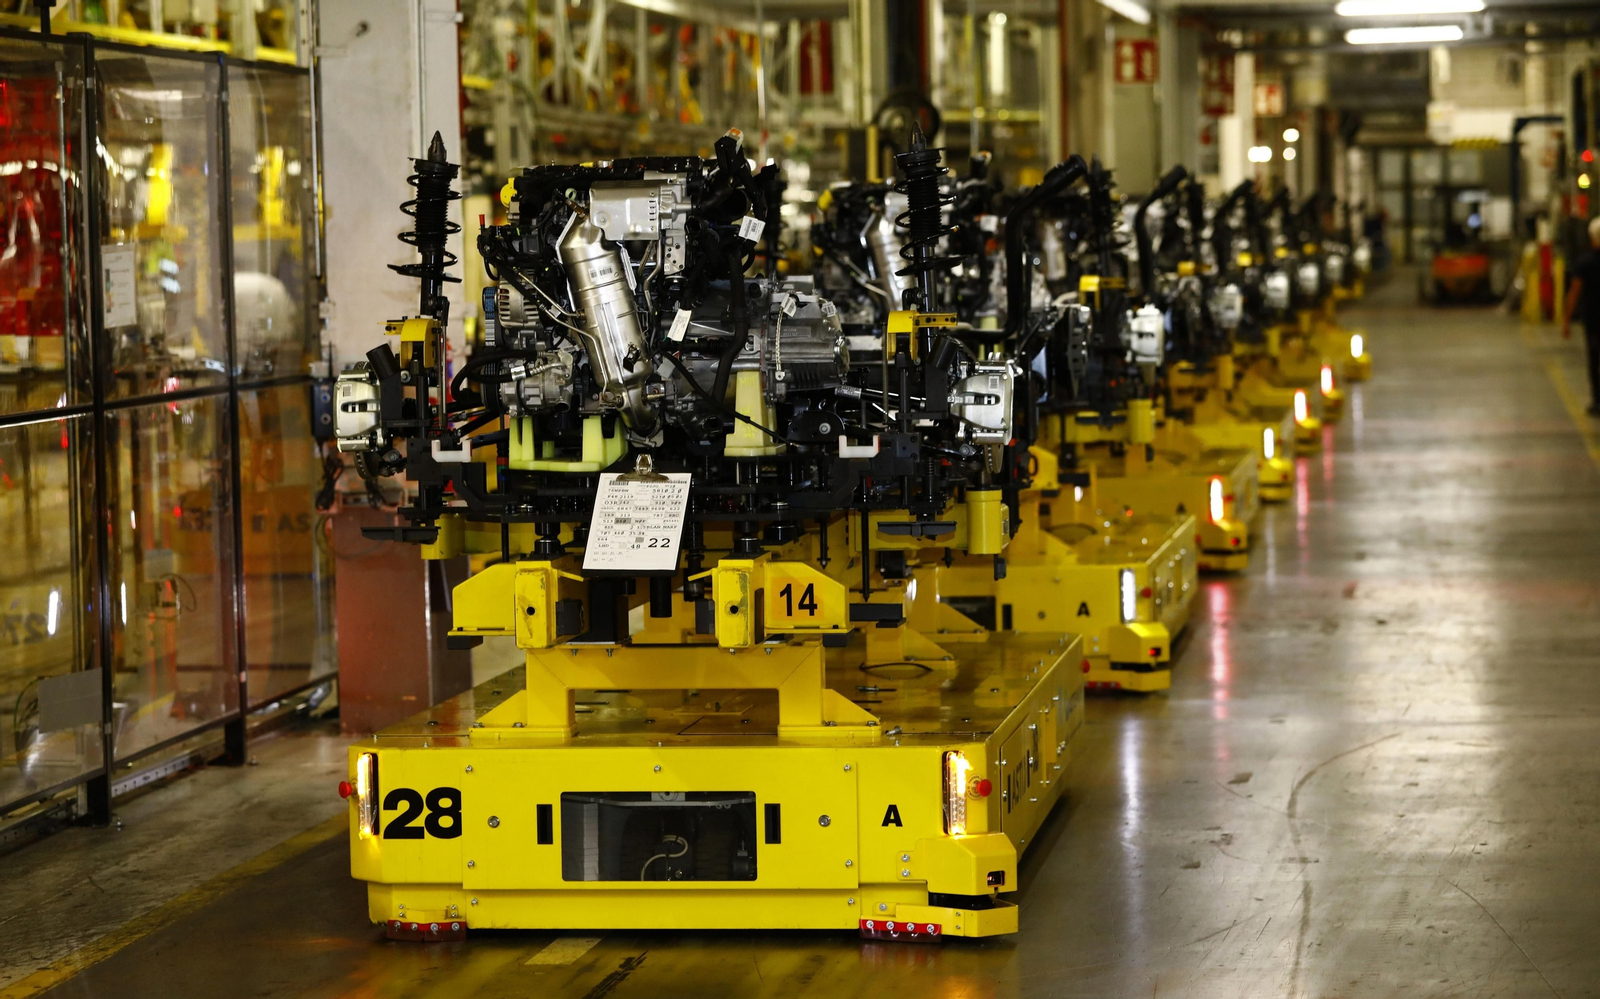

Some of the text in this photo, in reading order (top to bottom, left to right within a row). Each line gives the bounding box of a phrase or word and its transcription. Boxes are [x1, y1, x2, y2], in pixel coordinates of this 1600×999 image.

[648, 538, 670, 548] 22
[779, 582, 818, 617] 14
[1077, 601, 1090, 617] A
[383, 787, 462, 839] 28
[882, 805, 902, 827] A
